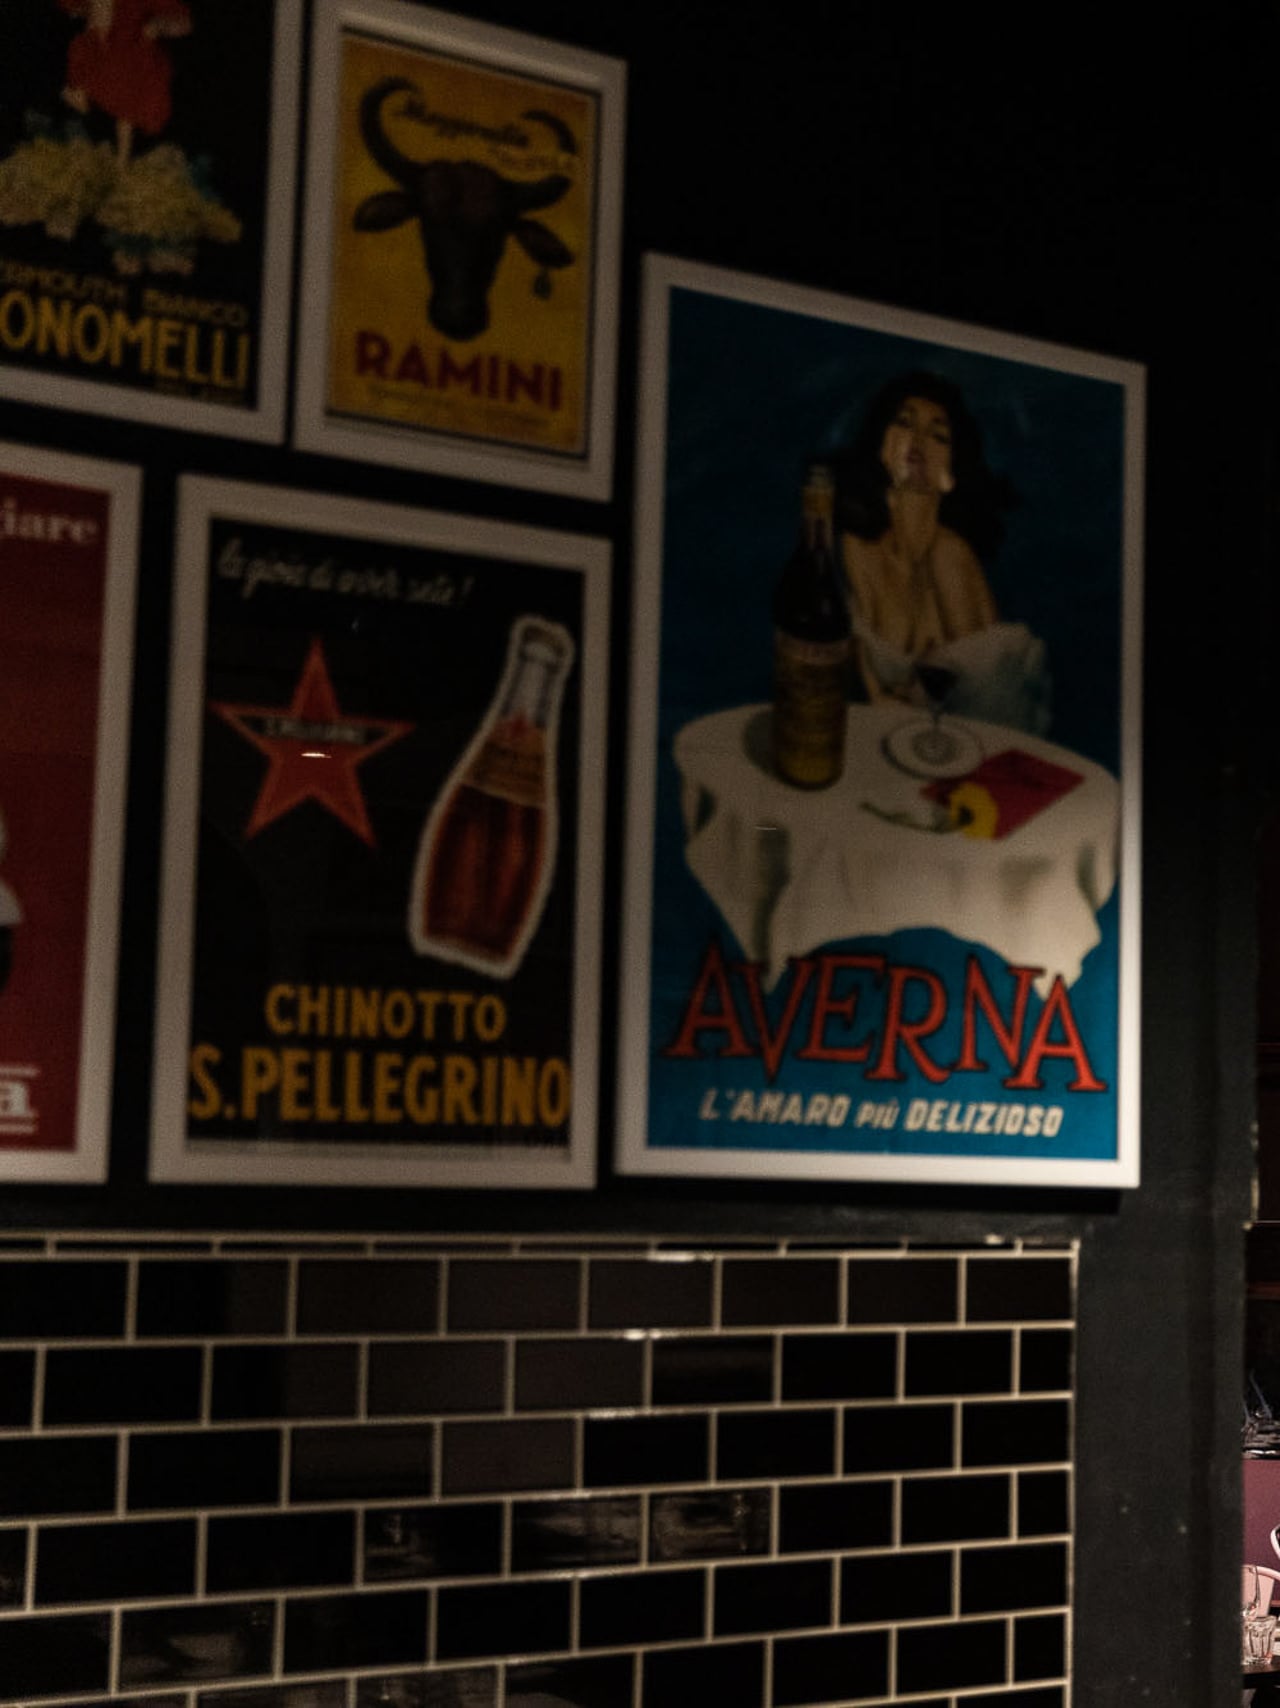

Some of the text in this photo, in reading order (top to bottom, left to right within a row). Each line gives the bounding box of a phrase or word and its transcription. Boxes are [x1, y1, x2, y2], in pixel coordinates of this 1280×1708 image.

[355, 329, 562, 411] RAMINI
[0, 497, 99, 544] iare
[263, 981, 509, 1043] CHINOTTO
[658, 934, 1110, 1093] AVERNA
[186, 1041, 573, 1129] S.PELLEGRINO
[699, 1087, 850, 1129] L'AMARO
[904, 1098, 1066, 1139] DELIZIOSO
